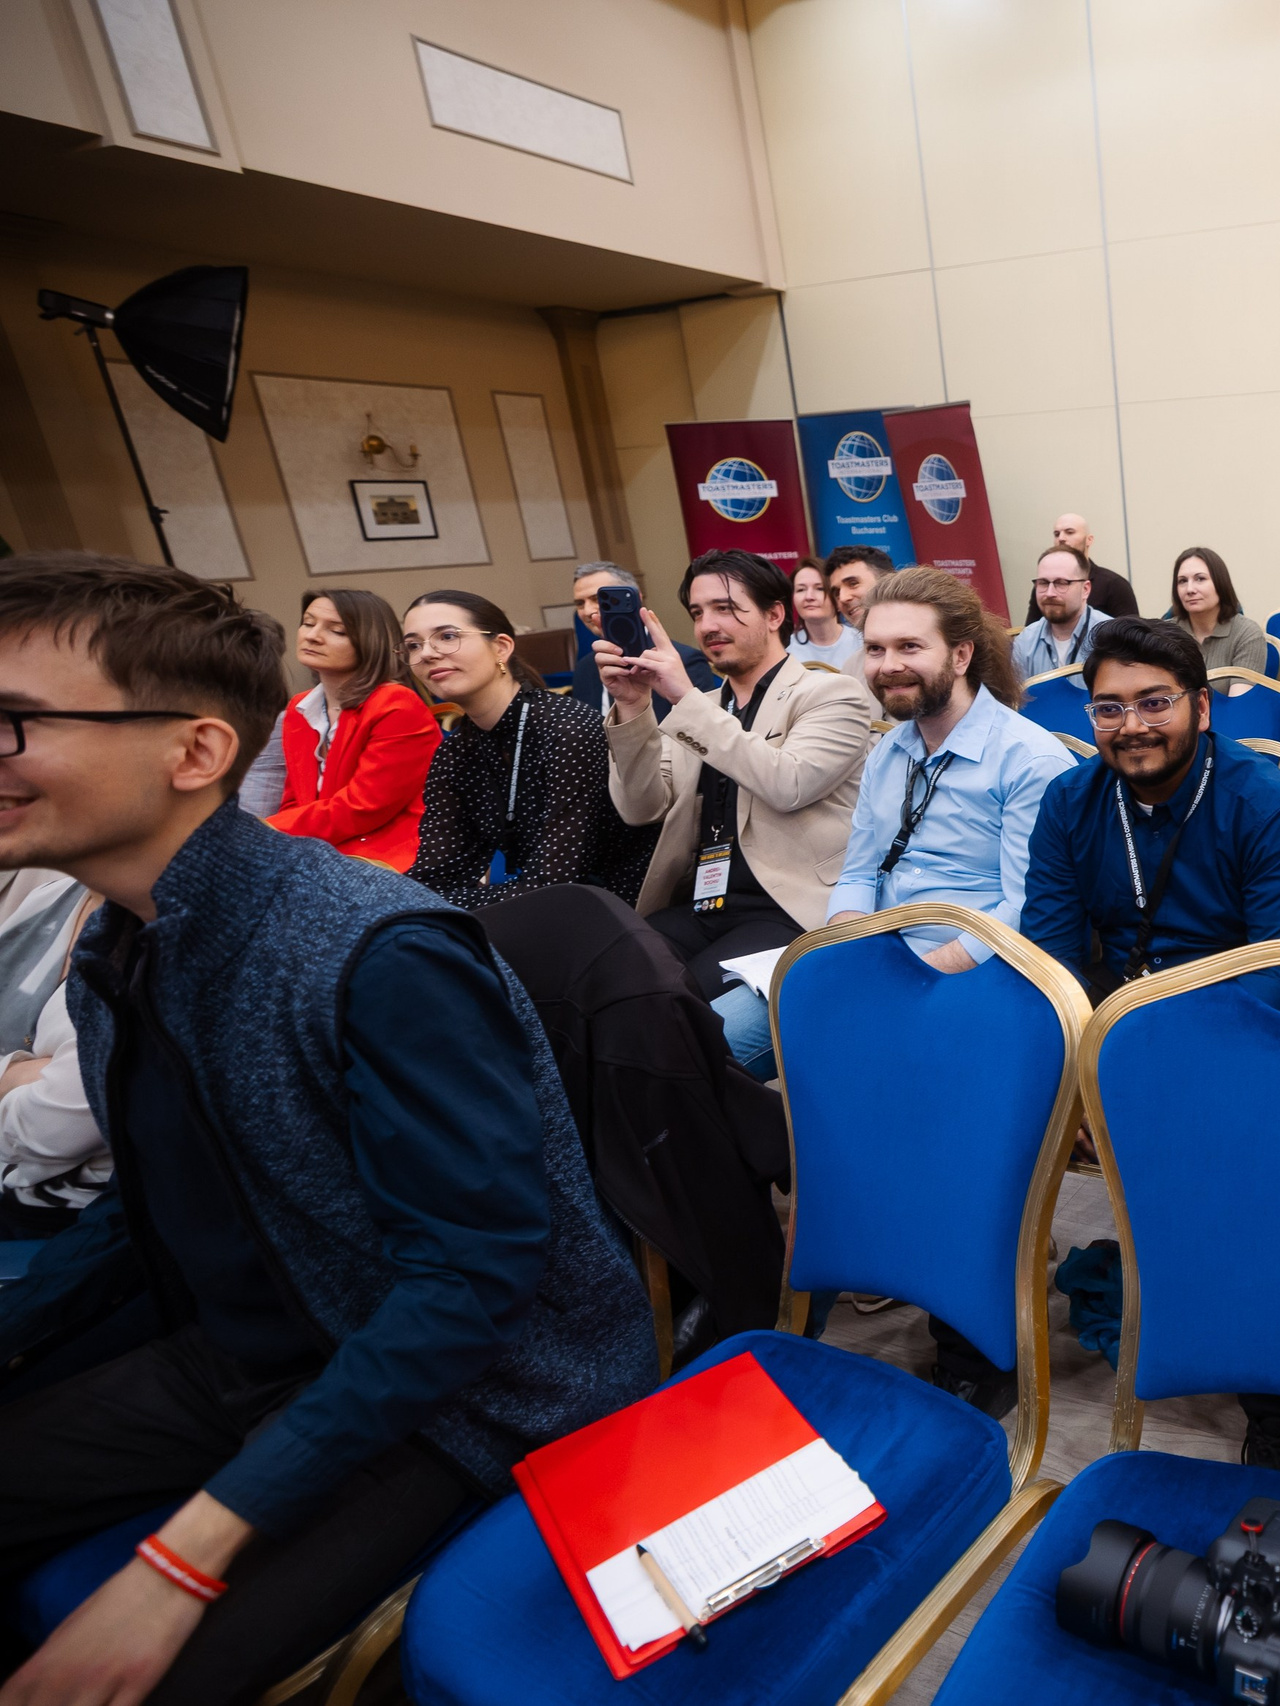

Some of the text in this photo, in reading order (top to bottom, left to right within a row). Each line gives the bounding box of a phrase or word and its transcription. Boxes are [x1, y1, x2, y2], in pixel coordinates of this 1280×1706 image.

[832, 460, 889, 469] TOASTMASTERS
[702, 483, 773, 492] TOASTMASTERS
[915, 482, 963, 492] TOASTMASTERS
[882, 514, 899, 522] Club
[851, 526, 886, 534] Bucharest
[1193, 769, 1210, 804] TOASTMASTERS
[1118, 801, 1130, 832] CONFERENCE
[1126, 837, 1135, 858] DIVISION
[1130, 859, 1142, 895] TOASTMASTERS
